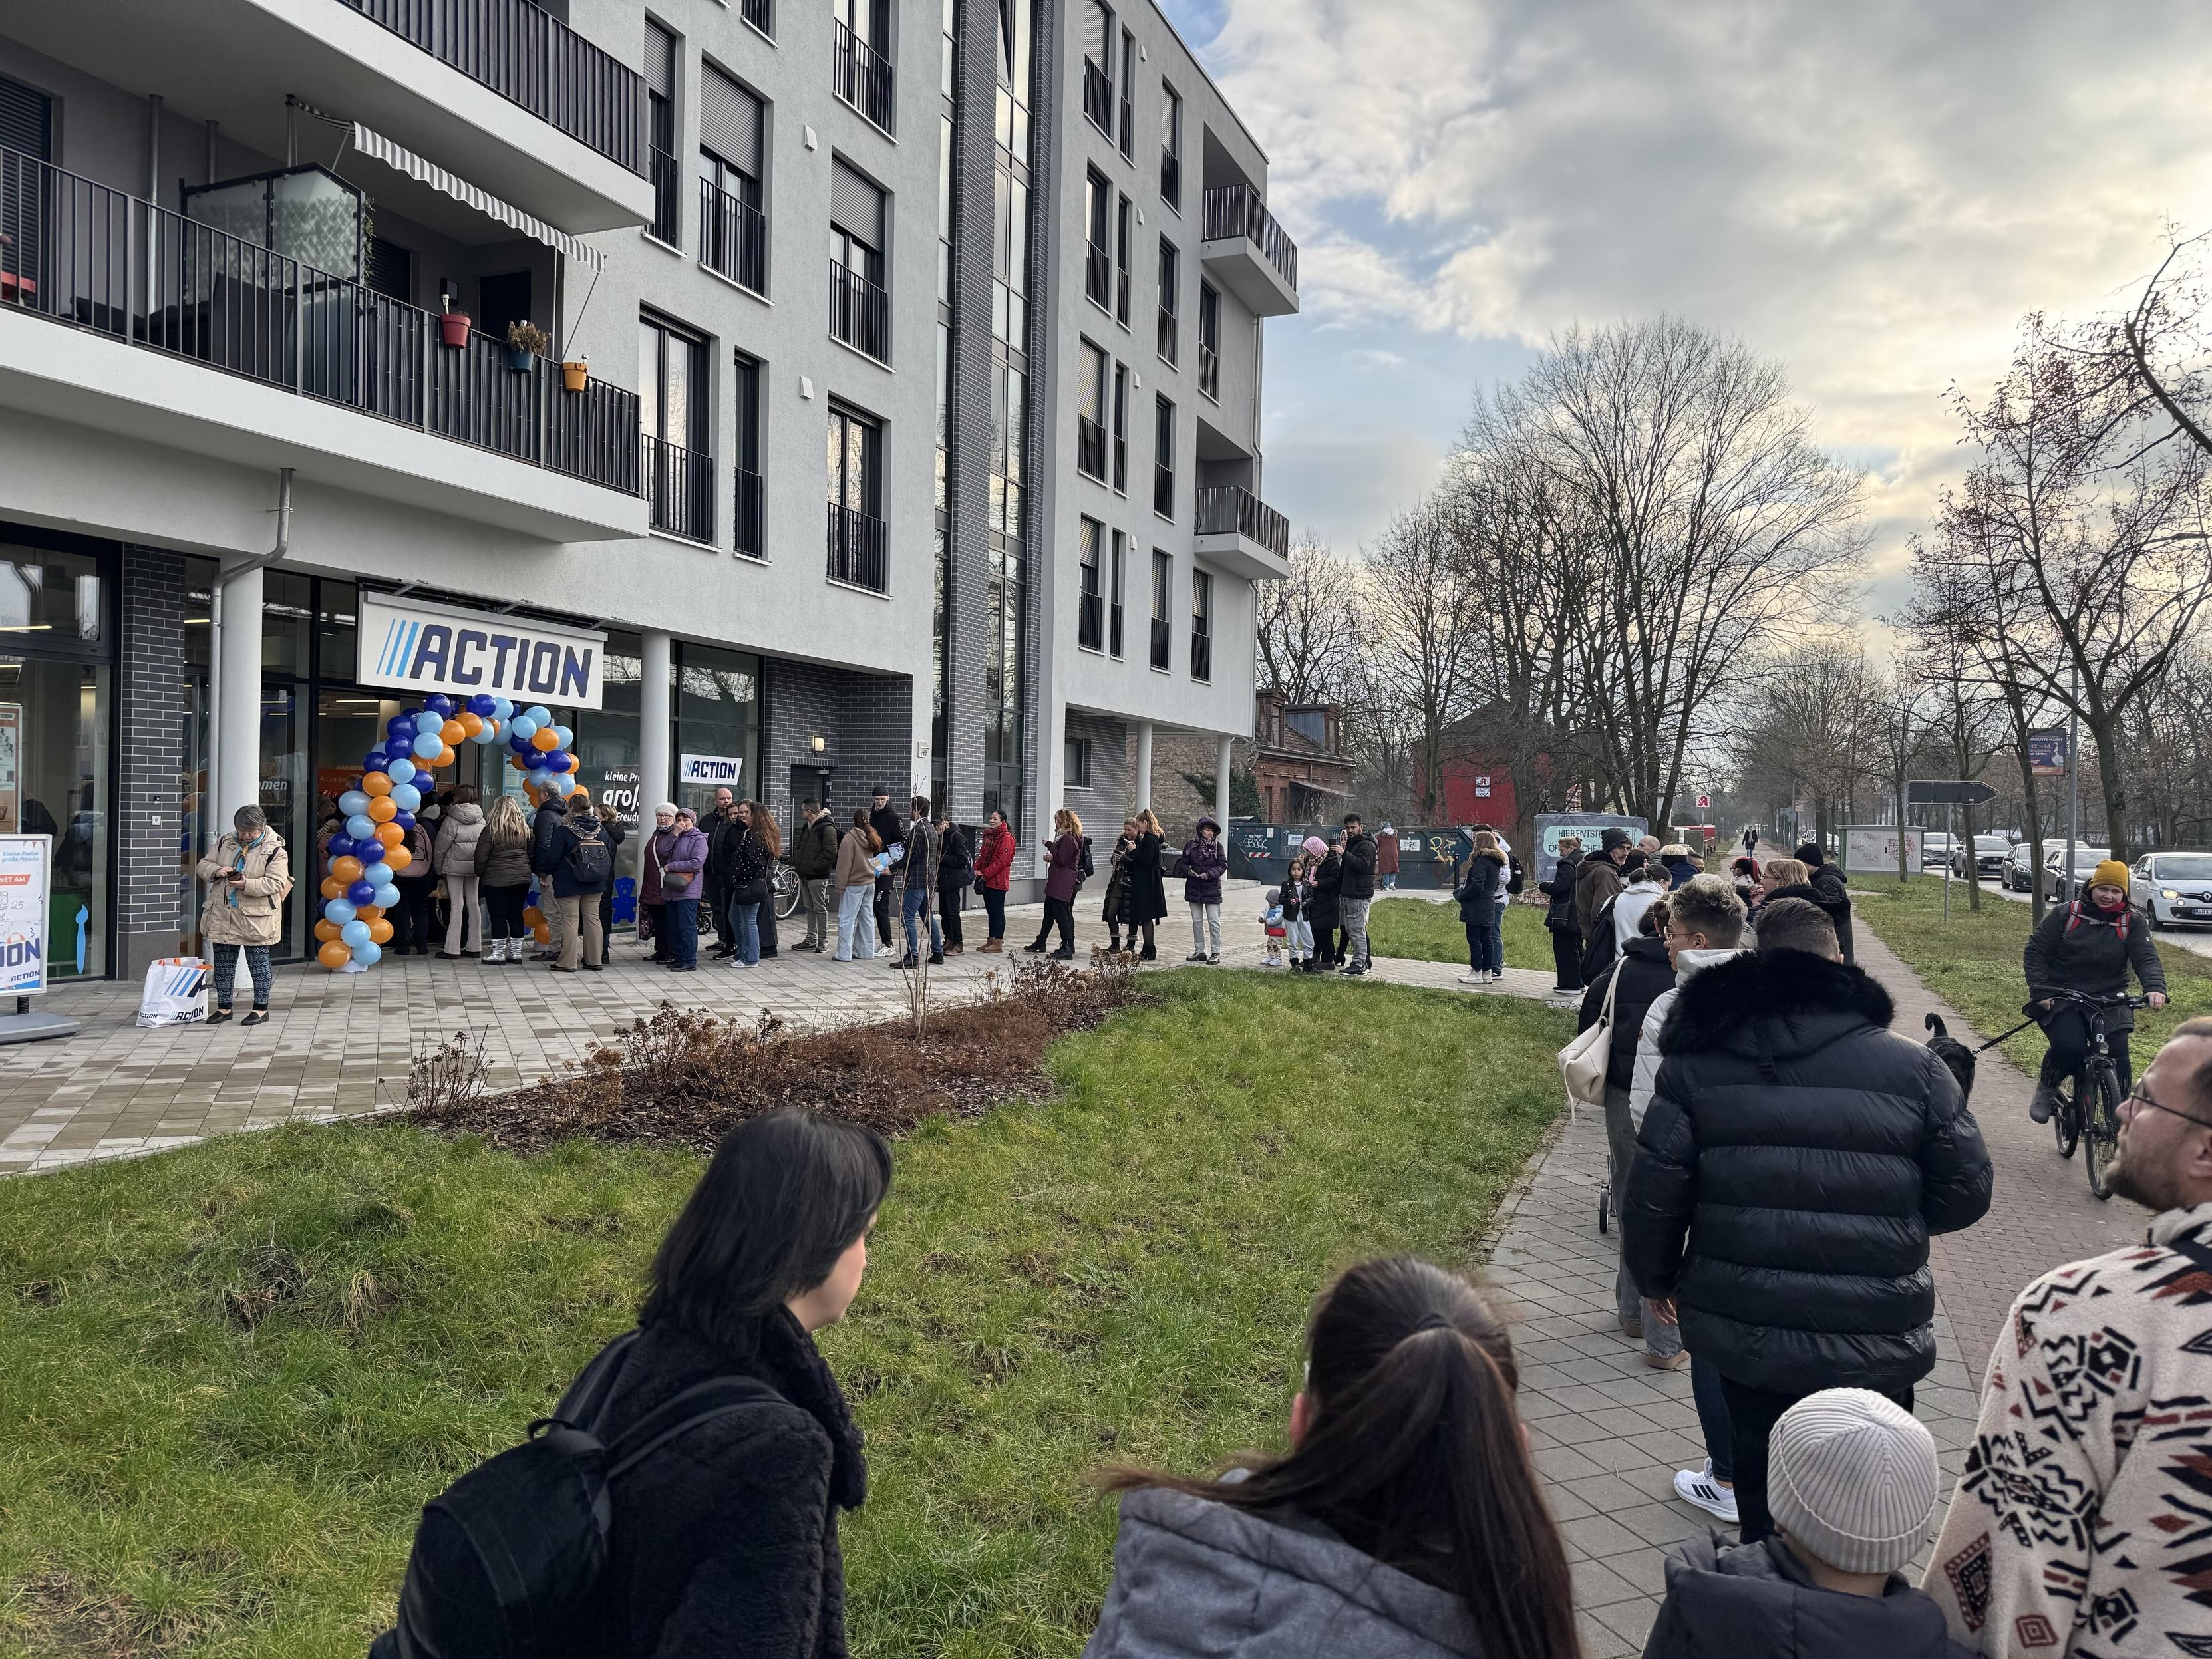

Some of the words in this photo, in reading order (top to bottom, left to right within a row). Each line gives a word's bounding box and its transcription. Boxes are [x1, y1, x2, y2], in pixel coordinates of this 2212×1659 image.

[408, 623, 593, 698] ACTION
[691, 760, 736, 779] ACTION
[605, 770, 628, 782] kleine
[259, 780, 288, 790] men
[1558, 829, 1575, 837] HIER
[10, 969, 40, 982] ACTION
